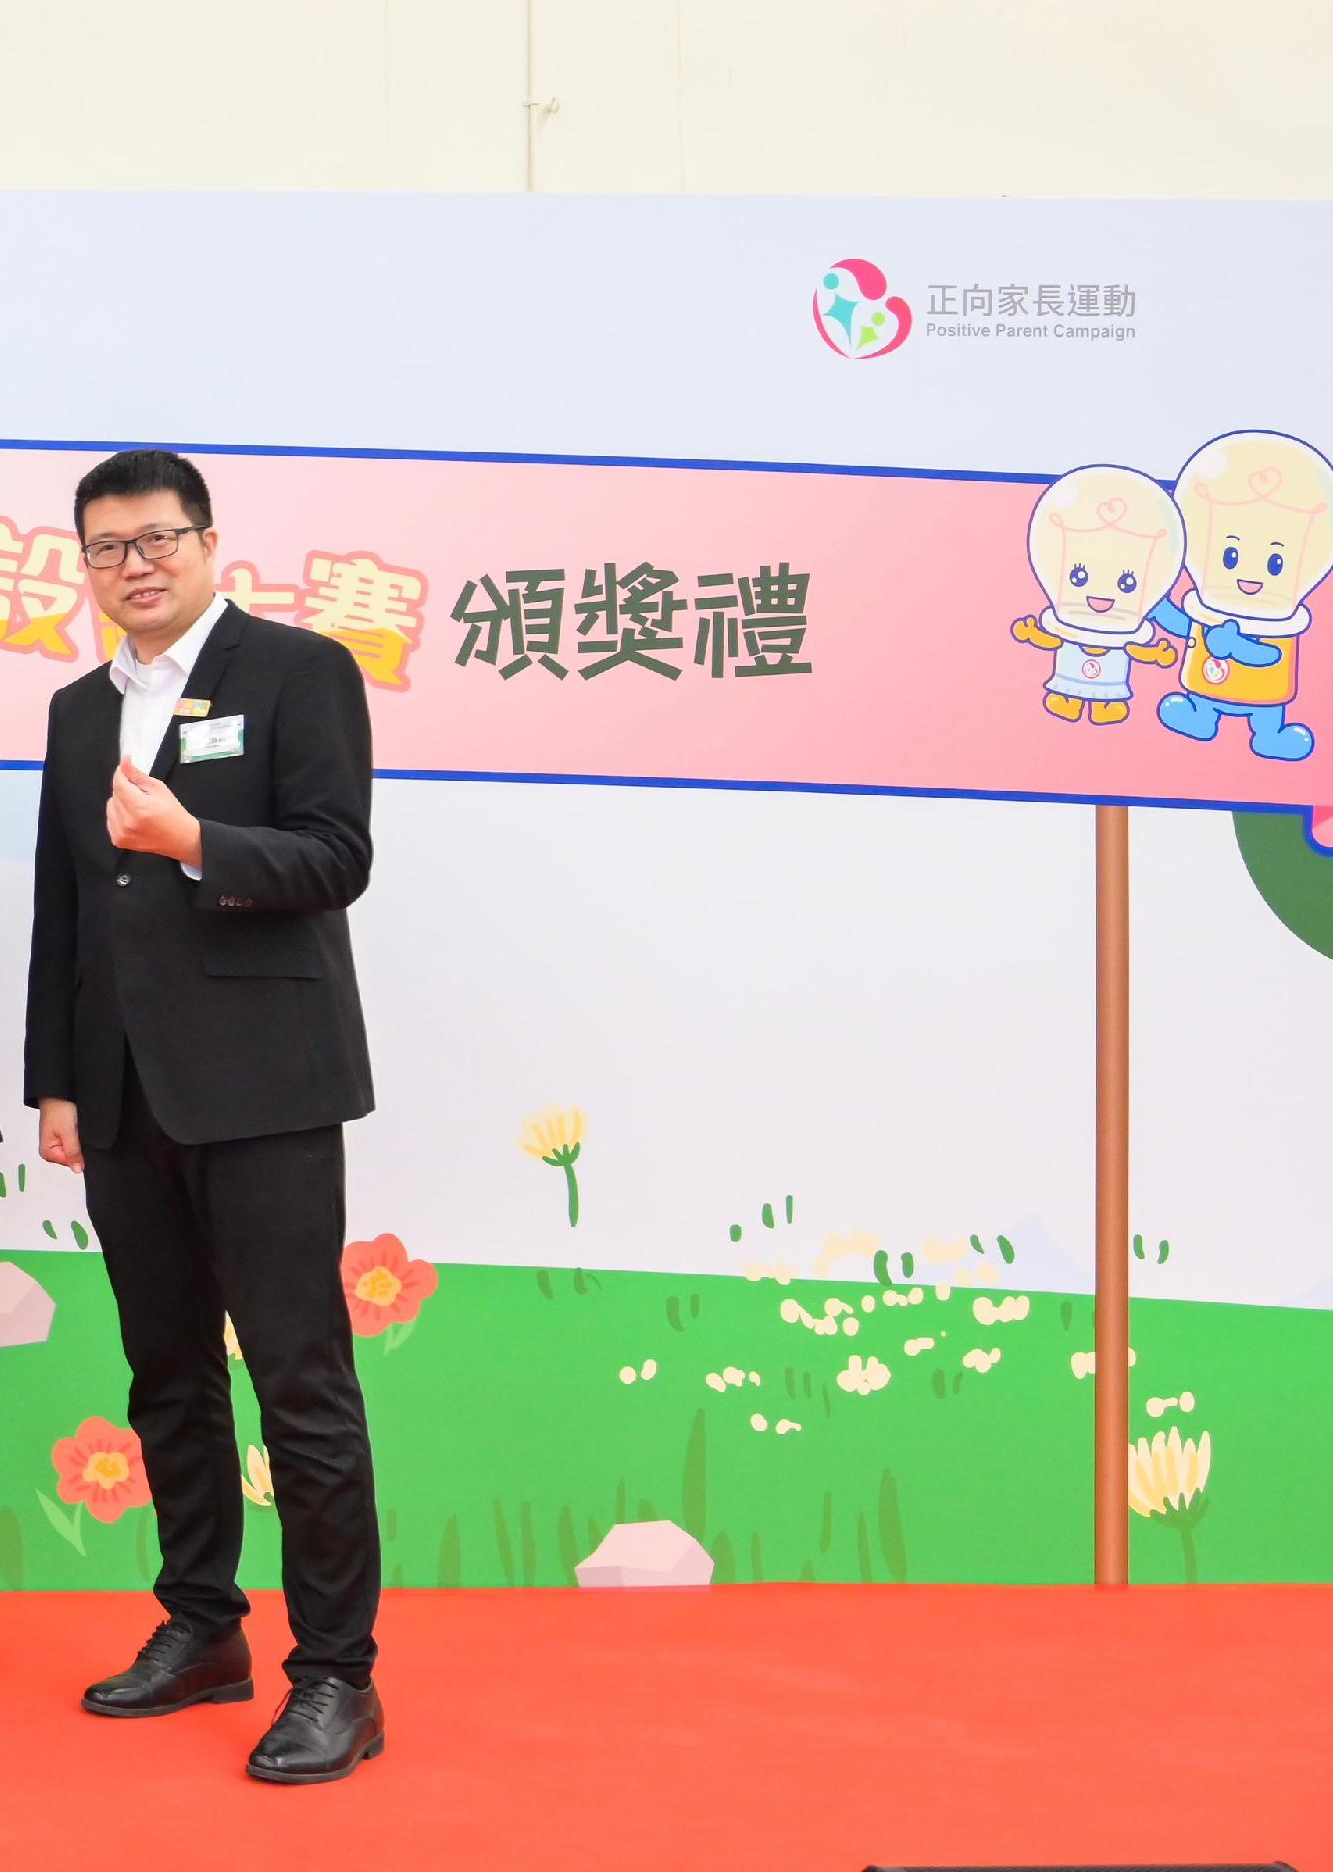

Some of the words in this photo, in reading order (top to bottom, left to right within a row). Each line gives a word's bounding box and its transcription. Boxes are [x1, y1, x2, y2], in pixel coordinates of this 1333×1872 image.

[927, 283, 1136, 317] 正向家長運動
[926, 323, 990, 338] Positive
[995, 323, 1048, 338] Parent
[1053, 324, 1136, 341] Campaign
[449, 561, 813, 681] 頒獎禮
